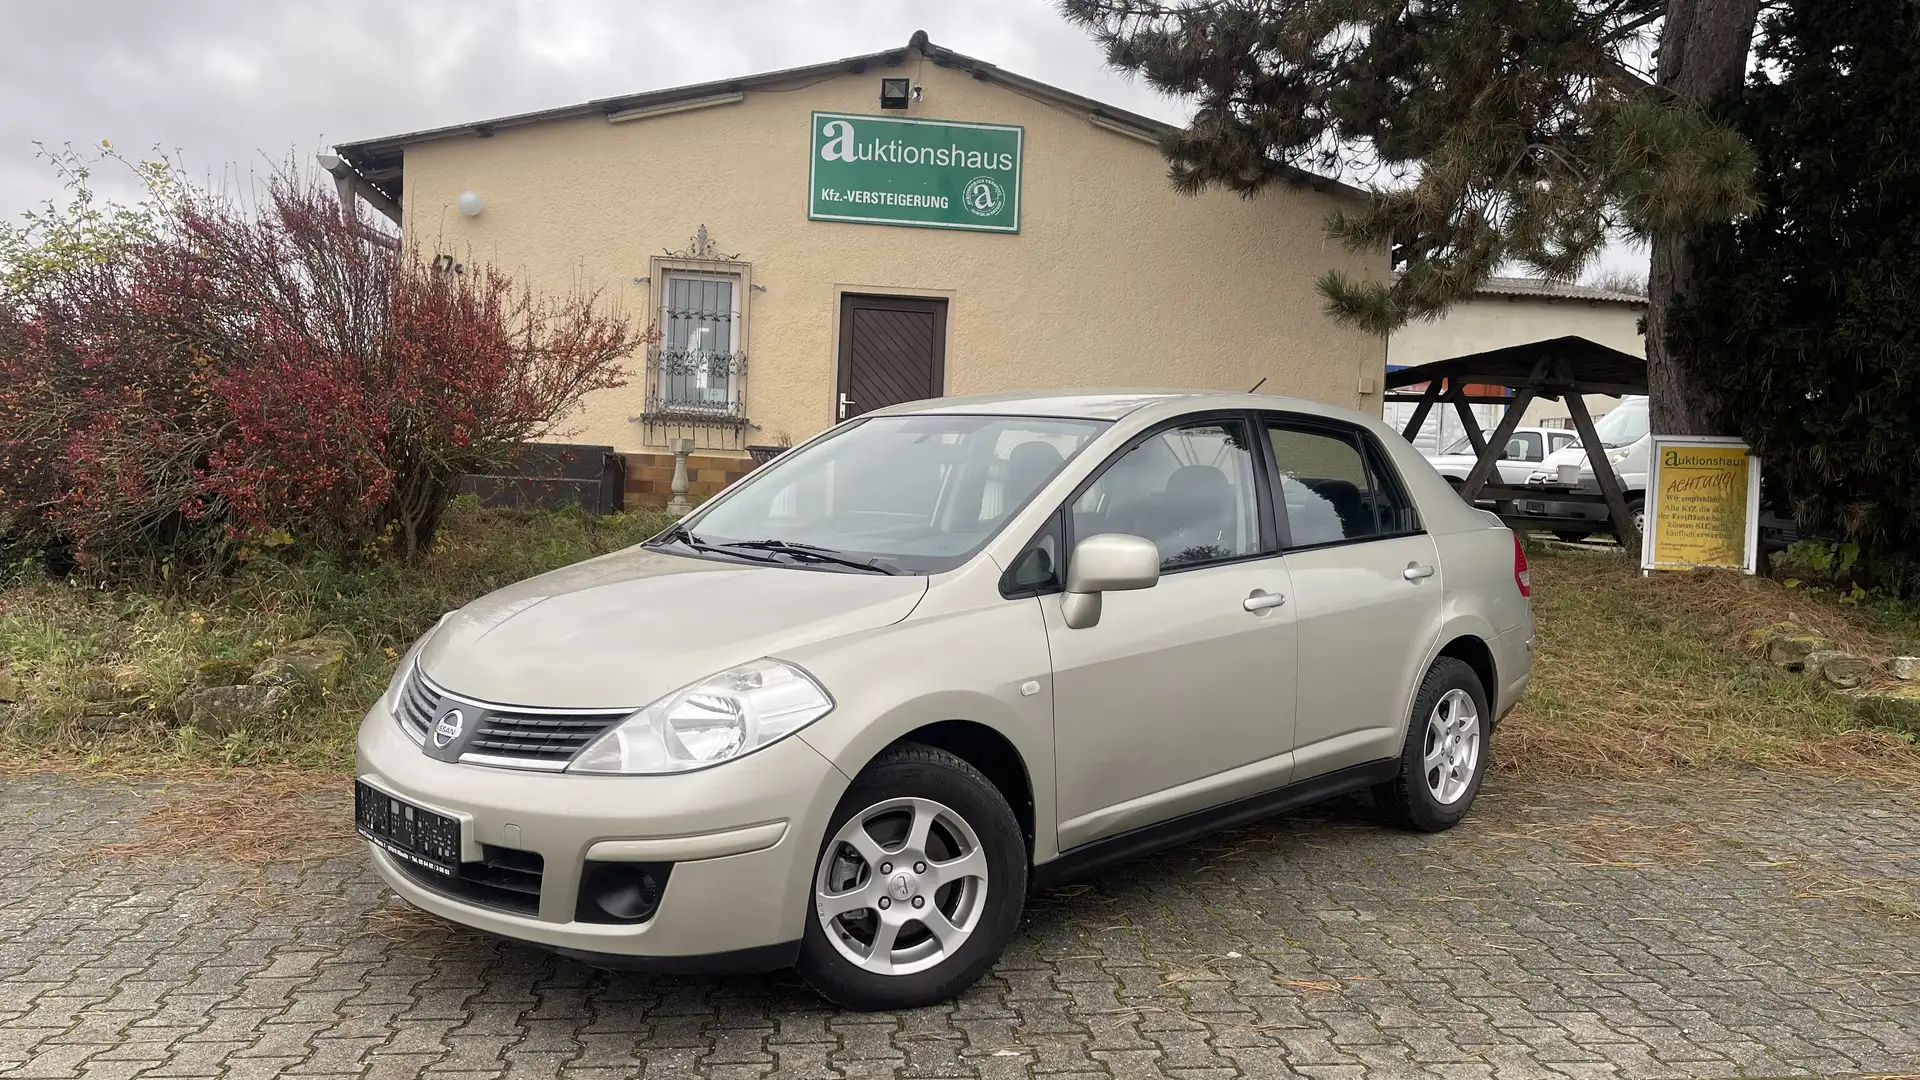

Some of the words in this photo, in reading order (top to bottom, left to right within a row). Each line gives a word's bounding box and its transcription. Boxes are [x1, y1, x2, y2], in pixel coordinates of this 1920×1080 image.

[820, 120, 1013, 171] auktionshaus
[821, 188, 949, 209] Kfz.-VERSTEIGERUNG
[973, 184, 996, 210] a
[1664, 450, 1746, 467] auktionshaus
